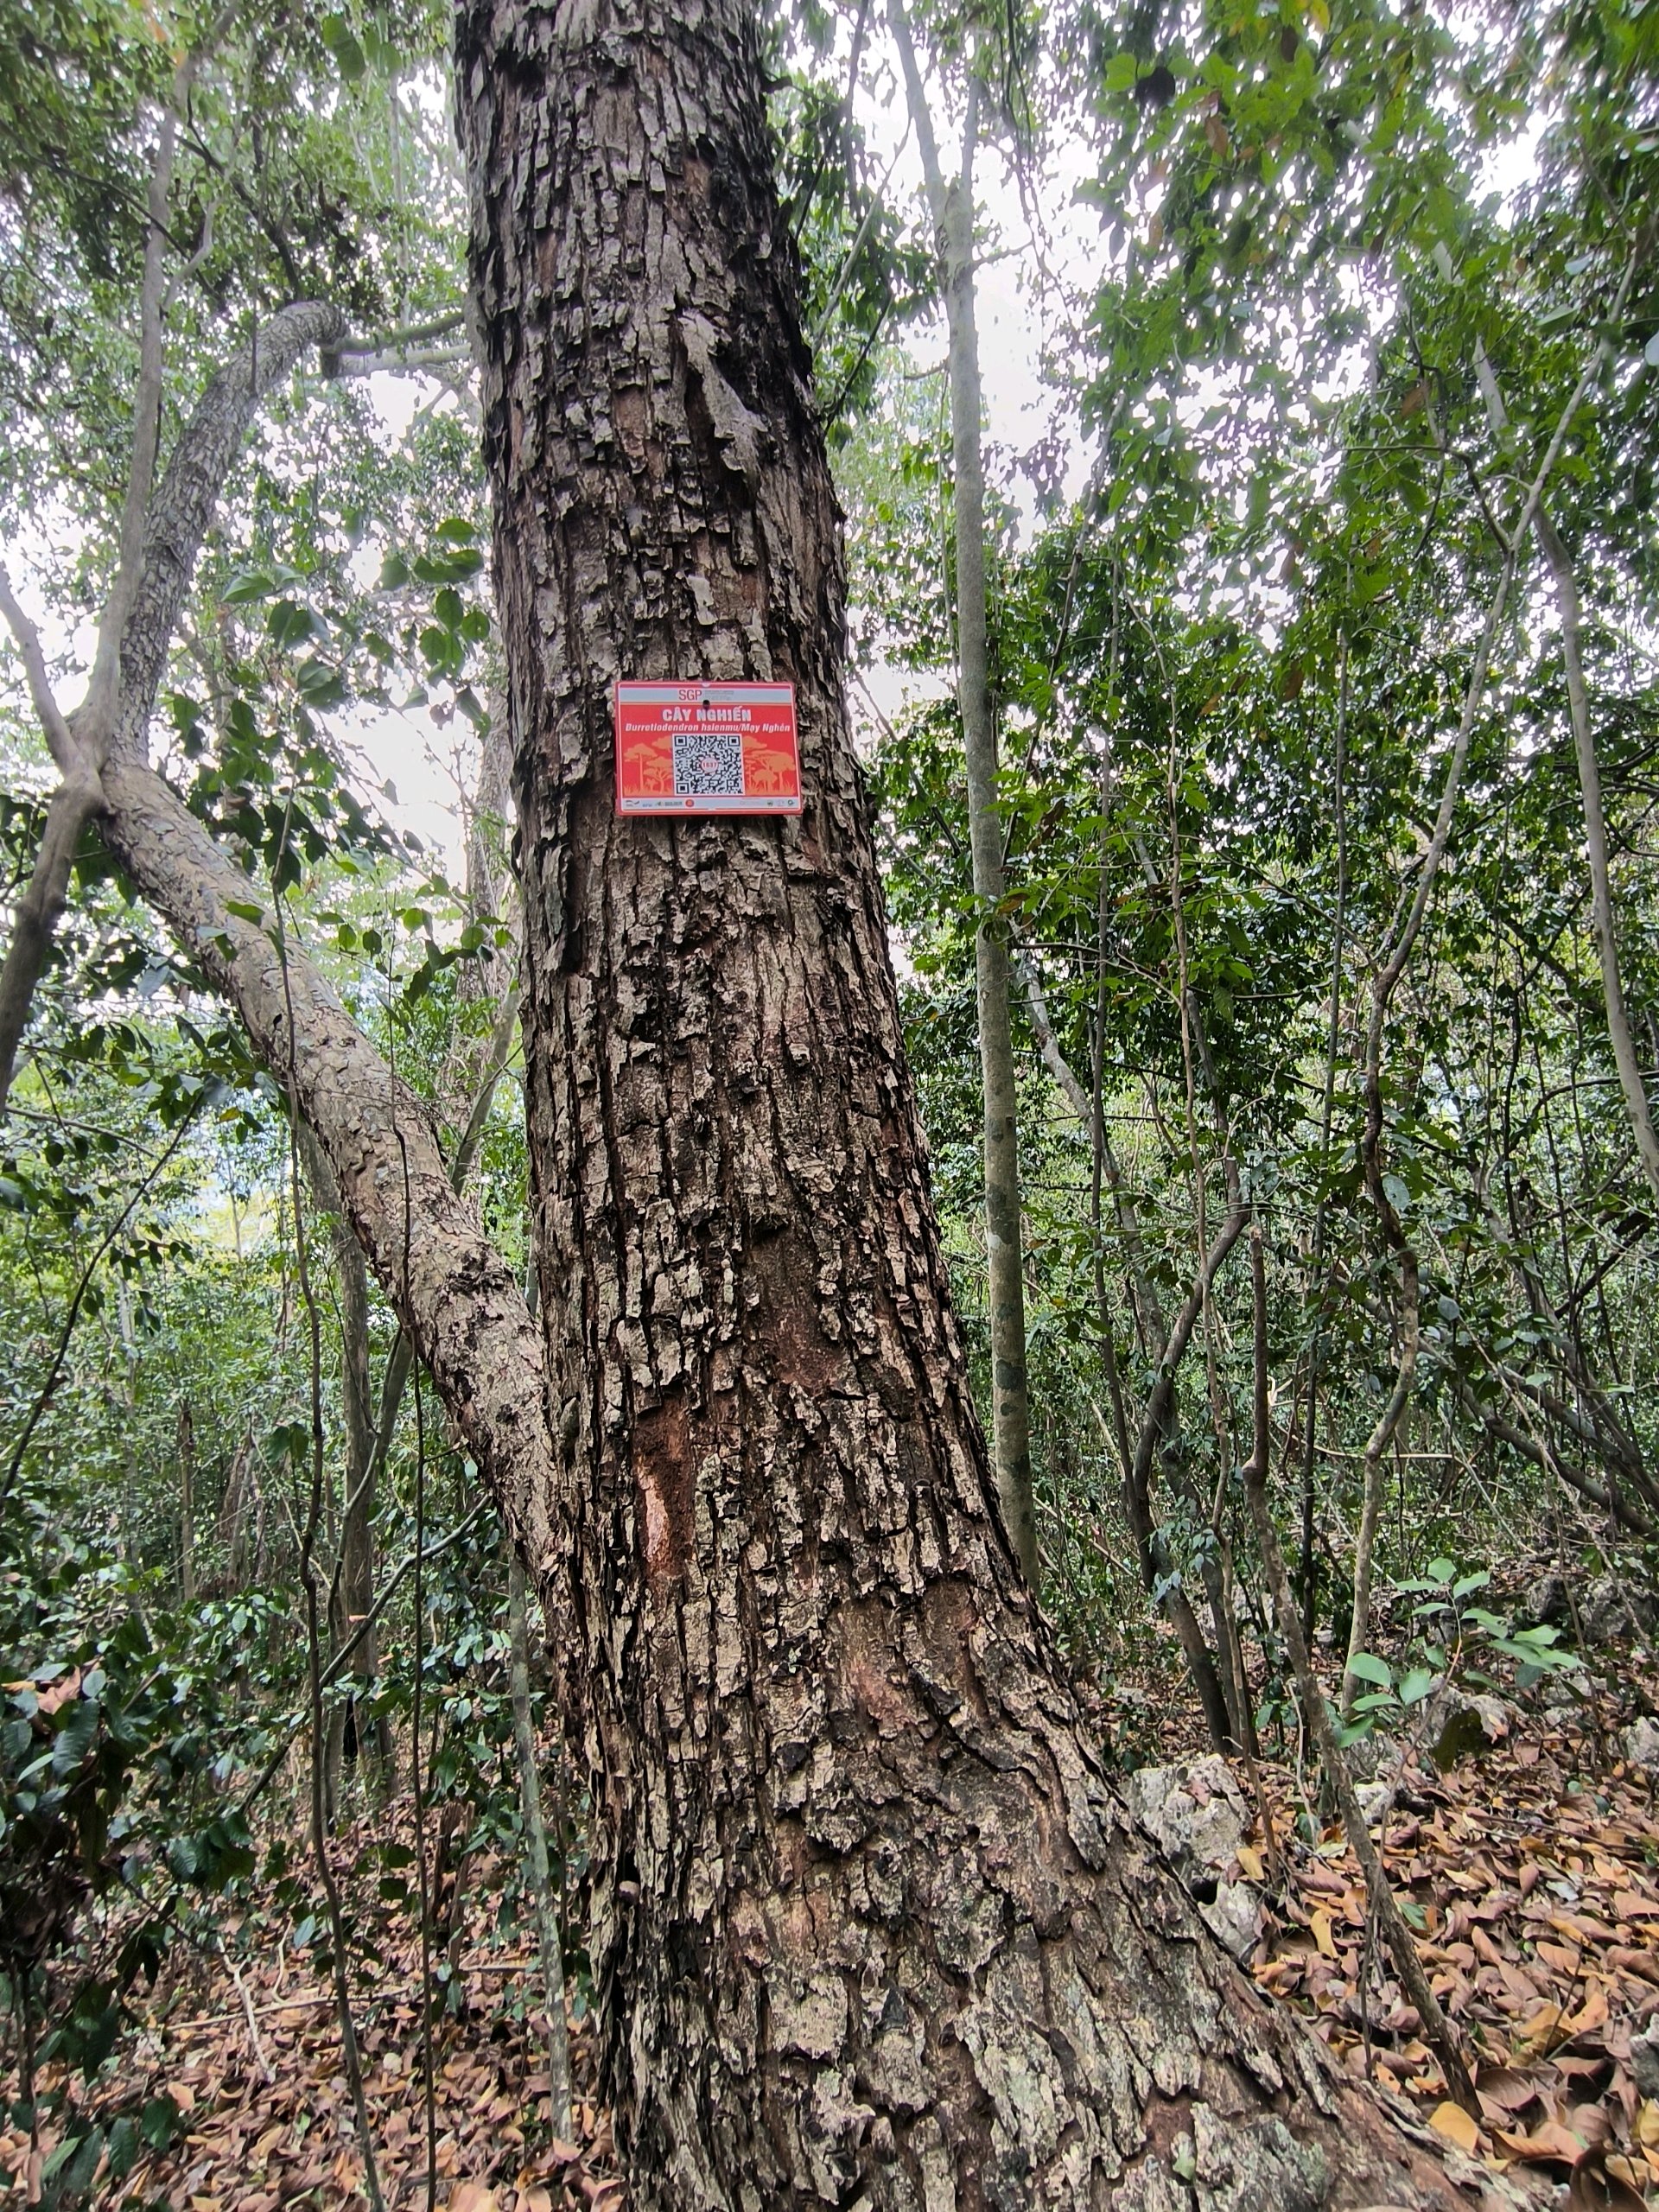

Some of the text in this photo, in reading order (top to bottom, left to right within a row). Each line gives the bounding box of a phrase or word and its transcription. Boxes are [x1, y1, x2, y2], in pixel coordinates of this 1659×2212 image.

[678, 690, 702, 701] SGP
[662, 706, 752, 721] CÂY NGHIẾN
[625, 722, 699, 732] Burretiodendron
